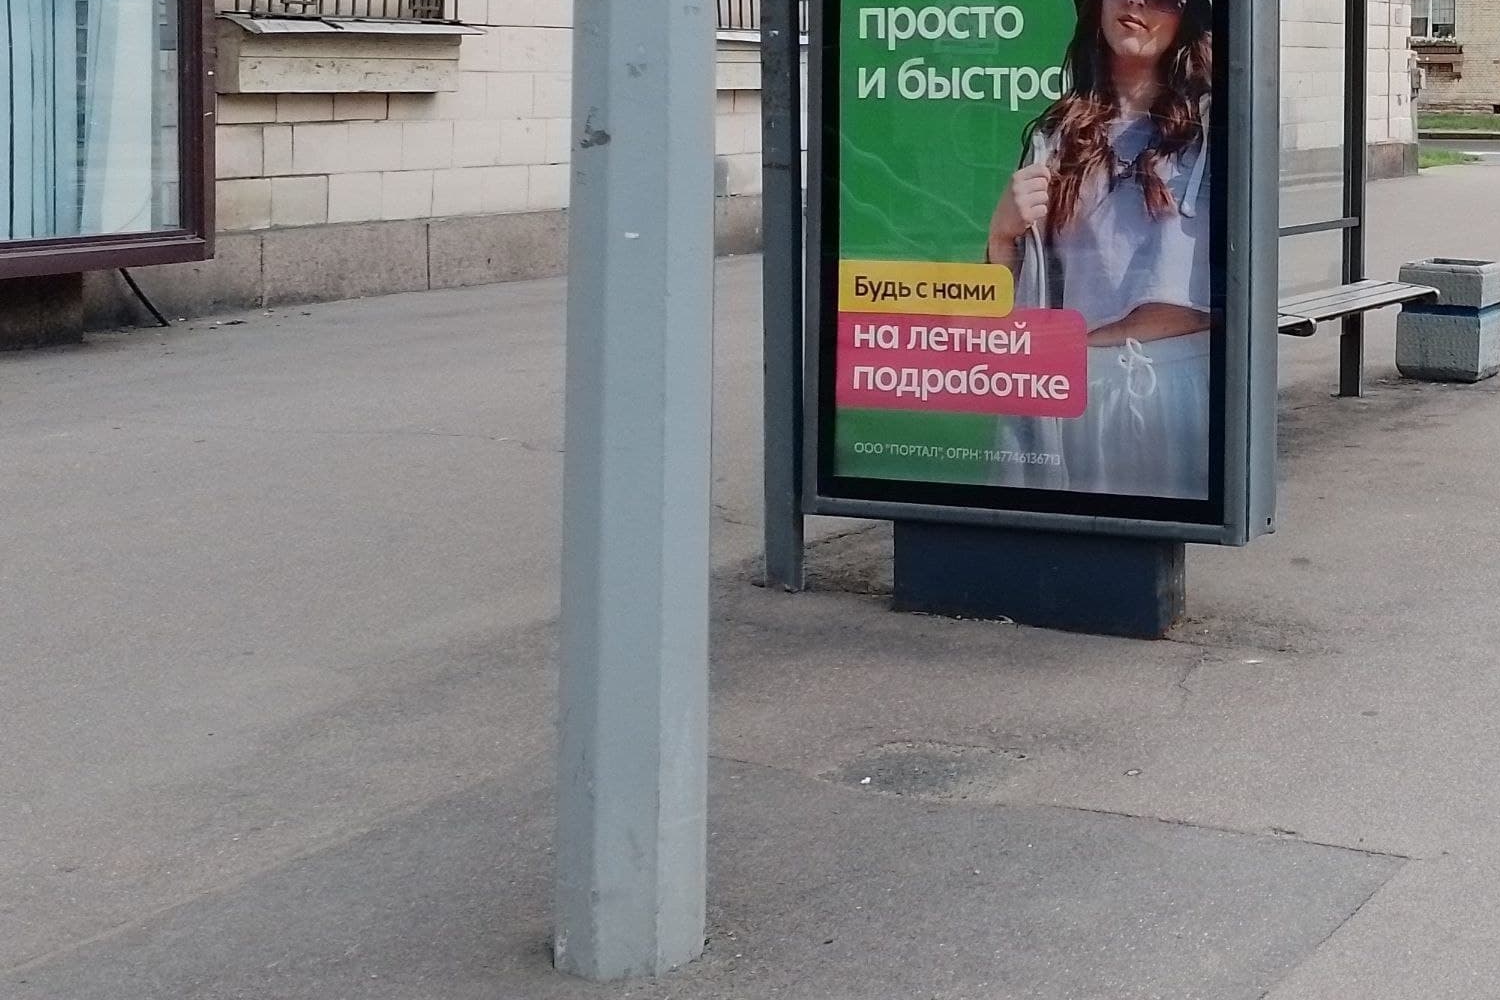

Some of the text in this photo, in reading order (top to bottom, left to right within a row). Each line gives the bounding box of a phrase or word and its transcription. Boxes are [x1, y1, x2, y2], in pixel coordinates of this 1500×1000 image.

[859, 5, 1024, 50] просто
[858, 58, 1074, 111] и быстро
[854, 275, 996, 302] Будь с нами
[854, 322, 1031, 355] на летней
[853, 364, 1070, 401] подработке
[854, 442, 884, 455] ООО
[946, 447, 982, 461] ОГРН:
